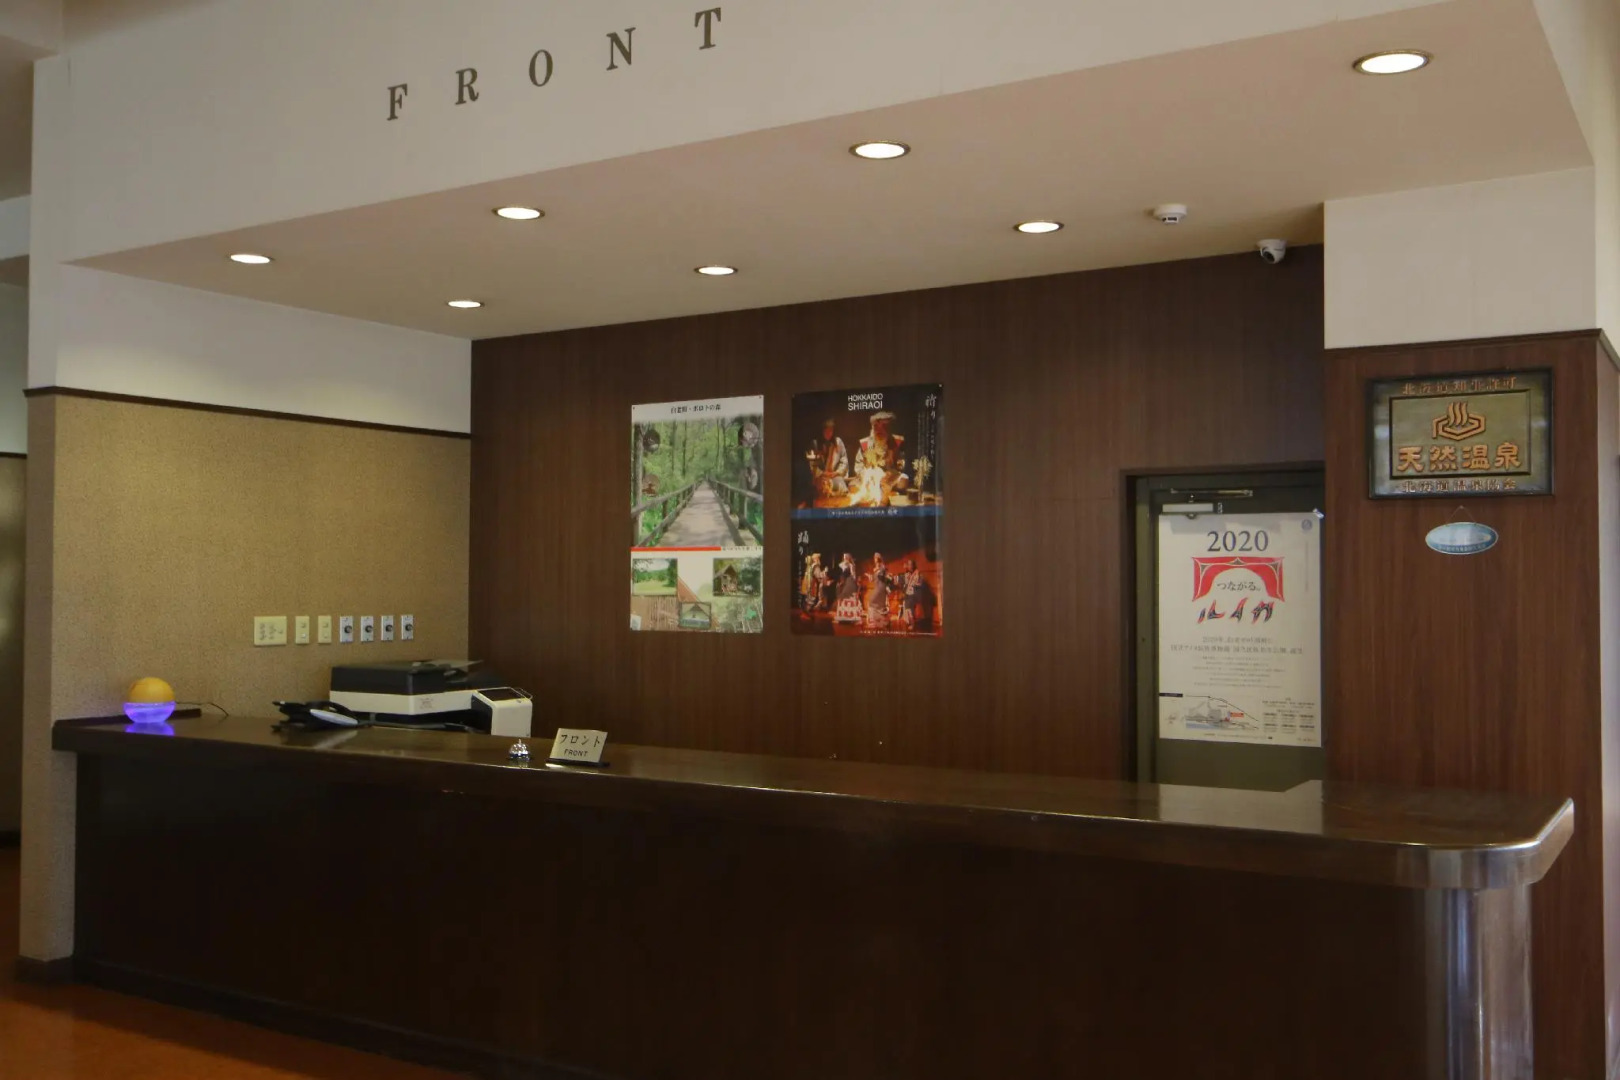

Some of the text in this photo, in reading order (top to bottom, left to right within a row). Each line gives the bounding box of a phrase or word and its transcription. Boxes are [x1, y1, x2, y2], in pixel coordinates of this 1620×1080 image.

[386, 7, 722, 121] FRONT
[847, 393, 884, 402] HOKKAIDO
[847, 400, 883, 411] SHIRAOI
[1396, 441, 1522, 473] 天然温泉
[1206, 530, 1269, 552] 2020
[559, 734, 601, 748] フロント
[564, 748, 589, 757] FRONT
